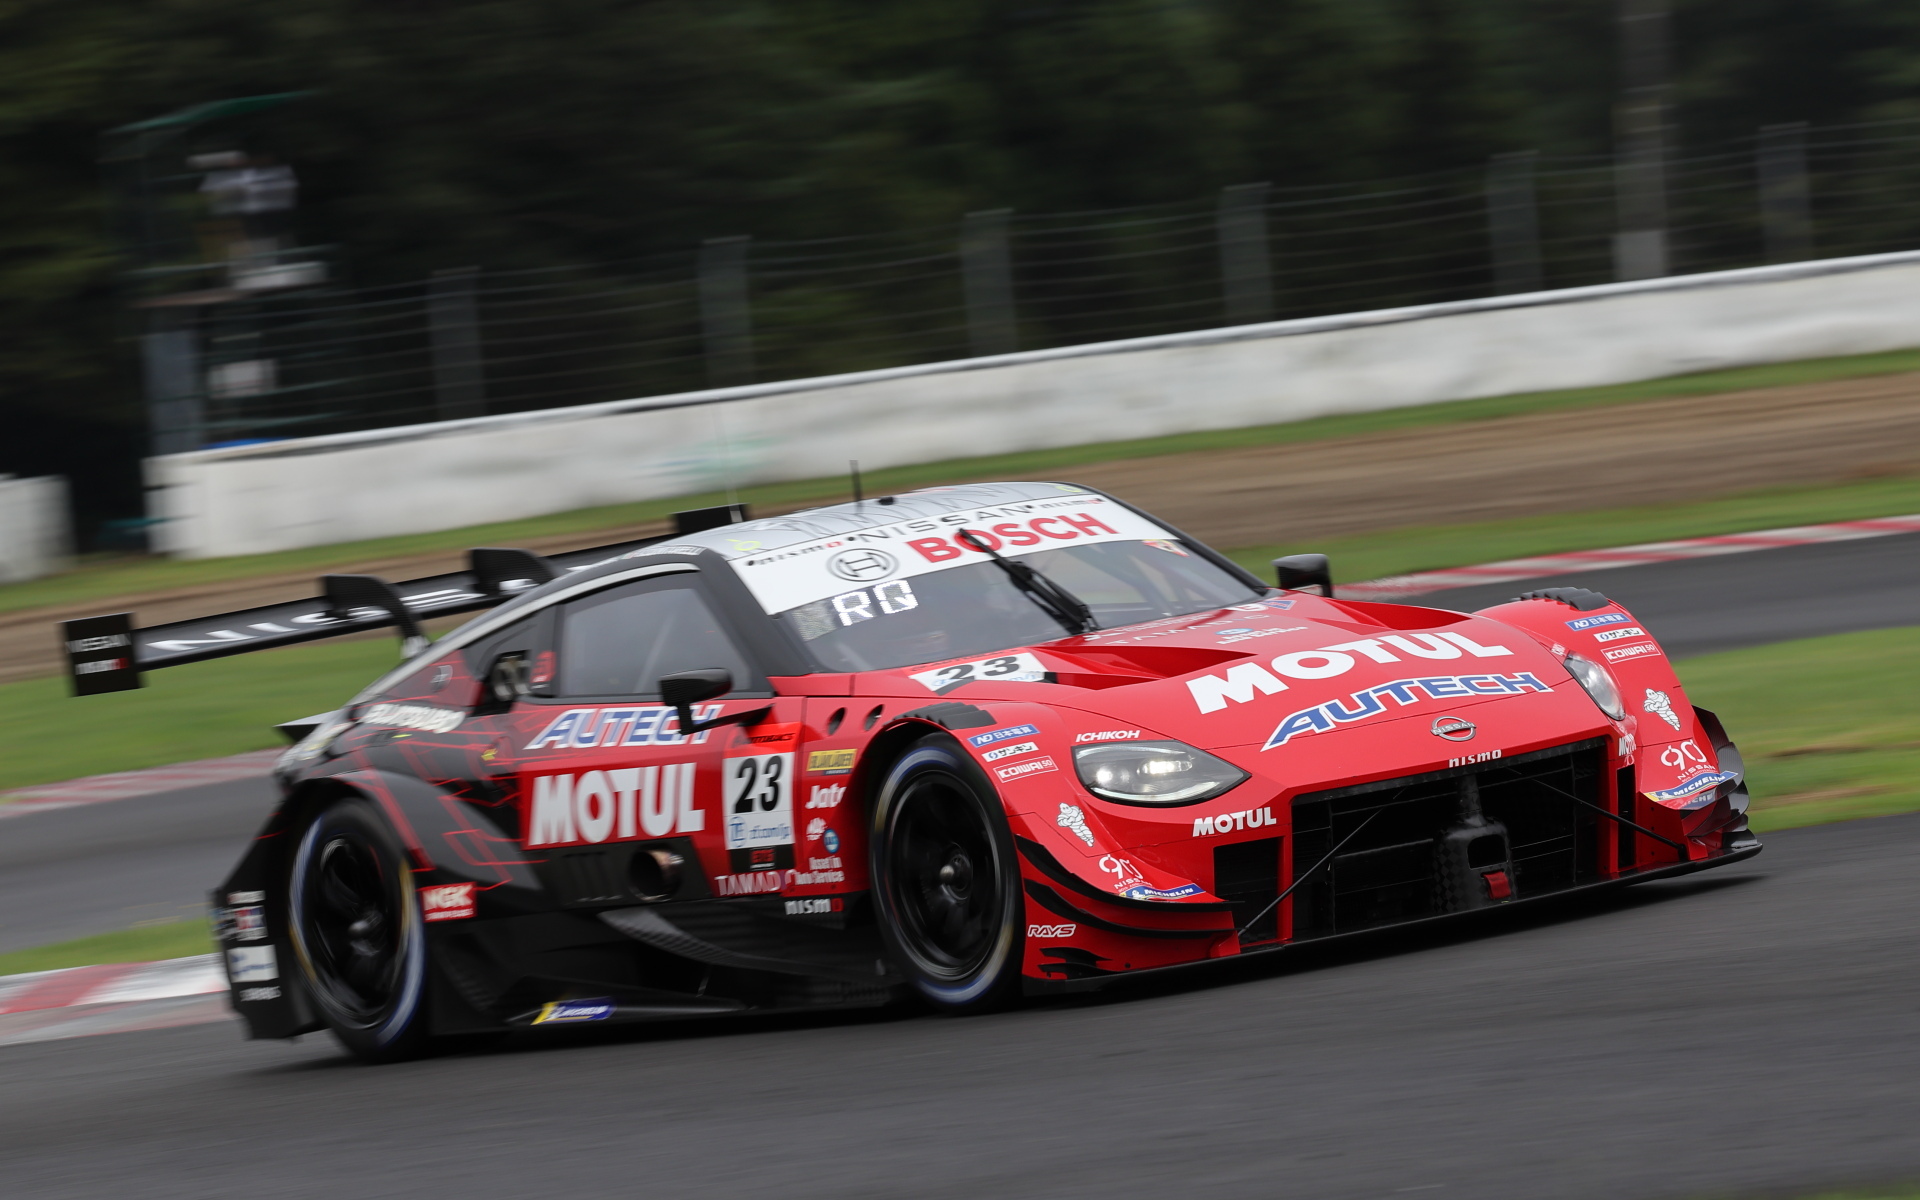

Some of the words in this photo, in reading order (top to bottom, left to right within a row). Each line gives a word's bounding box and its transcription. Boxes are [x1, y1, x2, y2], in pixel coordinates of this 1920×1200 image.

[856, 503, 1033, 543] NISSAN
[906, 512, 1121, 563] BOSCH
[935, 656, 1020, 684] 23
[1186, 632, 1514, 715] MOTUL
[1259, 671, 1555, 753] AUTECH
[1075, 730, 1141, 743] ICHIKOH
[1433, 722, 1475, 735] NISSAN
[998, 744, 1033, 757] サンキン
[1448, 748, 1502, 769] nismo
[998, 761, 1044, 779] KOIWAI
[1677, 765, 1716, 780] NISSAN
[734, 754, 784, 814] 23
[1673, 774, 1726, 797] MICHELIN
[529, 762, 706, 847] MOTUL
[1192, 806, 1277, 838] MOTUL
[1144, 887, 1194, 898] MICHELIN
[785, 897, 844, 916] nismo
[1027, 923, 1077, 938] RAYS
